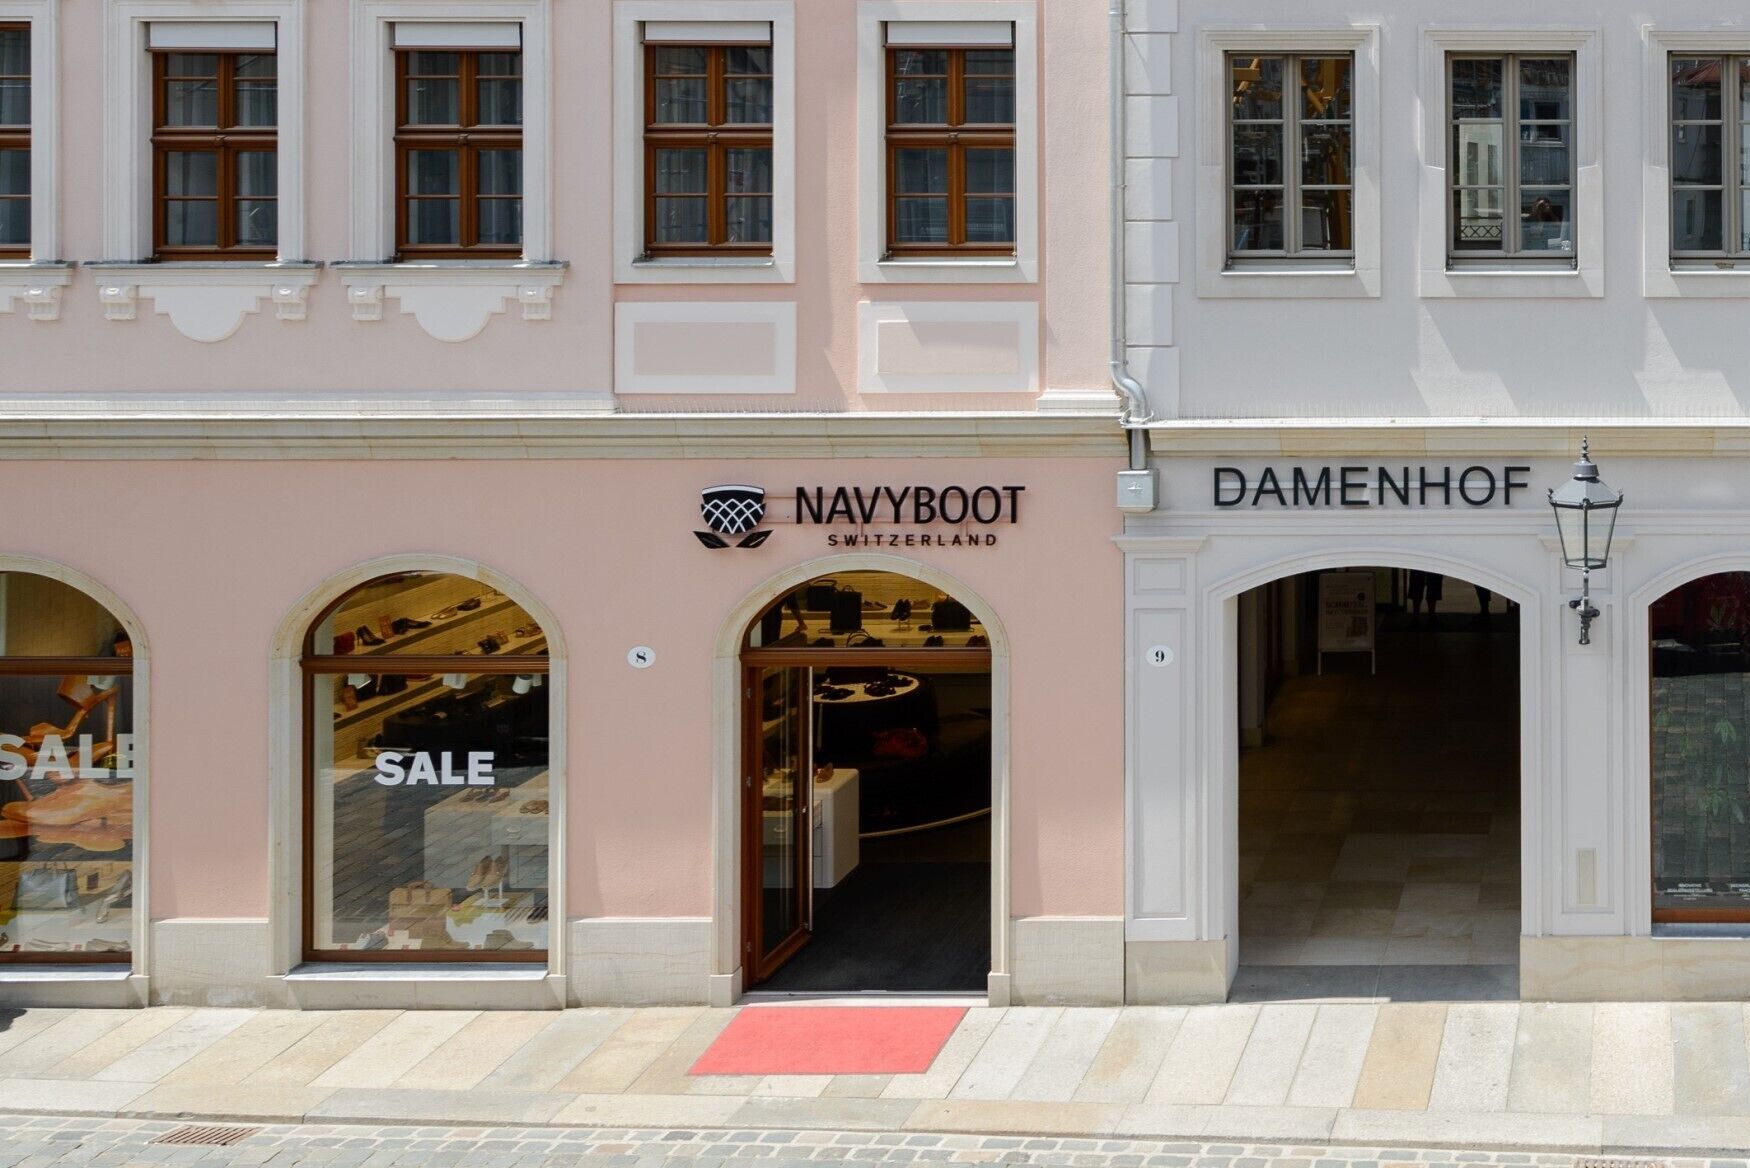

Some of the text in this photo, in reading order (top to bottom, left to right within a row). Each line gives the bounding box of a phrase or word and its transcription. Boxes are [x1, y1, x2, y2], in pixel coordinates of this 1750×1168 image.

[1213, 465, 1531, 507] DAMENHOF
[795, 485, 1026, 525] NAVYBOOT
[827, 533, 997, 547] SWITZERLAND
[635, 650, 647, 664] 8
[1154, 649, 1166, 663] 9
[375, 751, 495, 786] SALE
